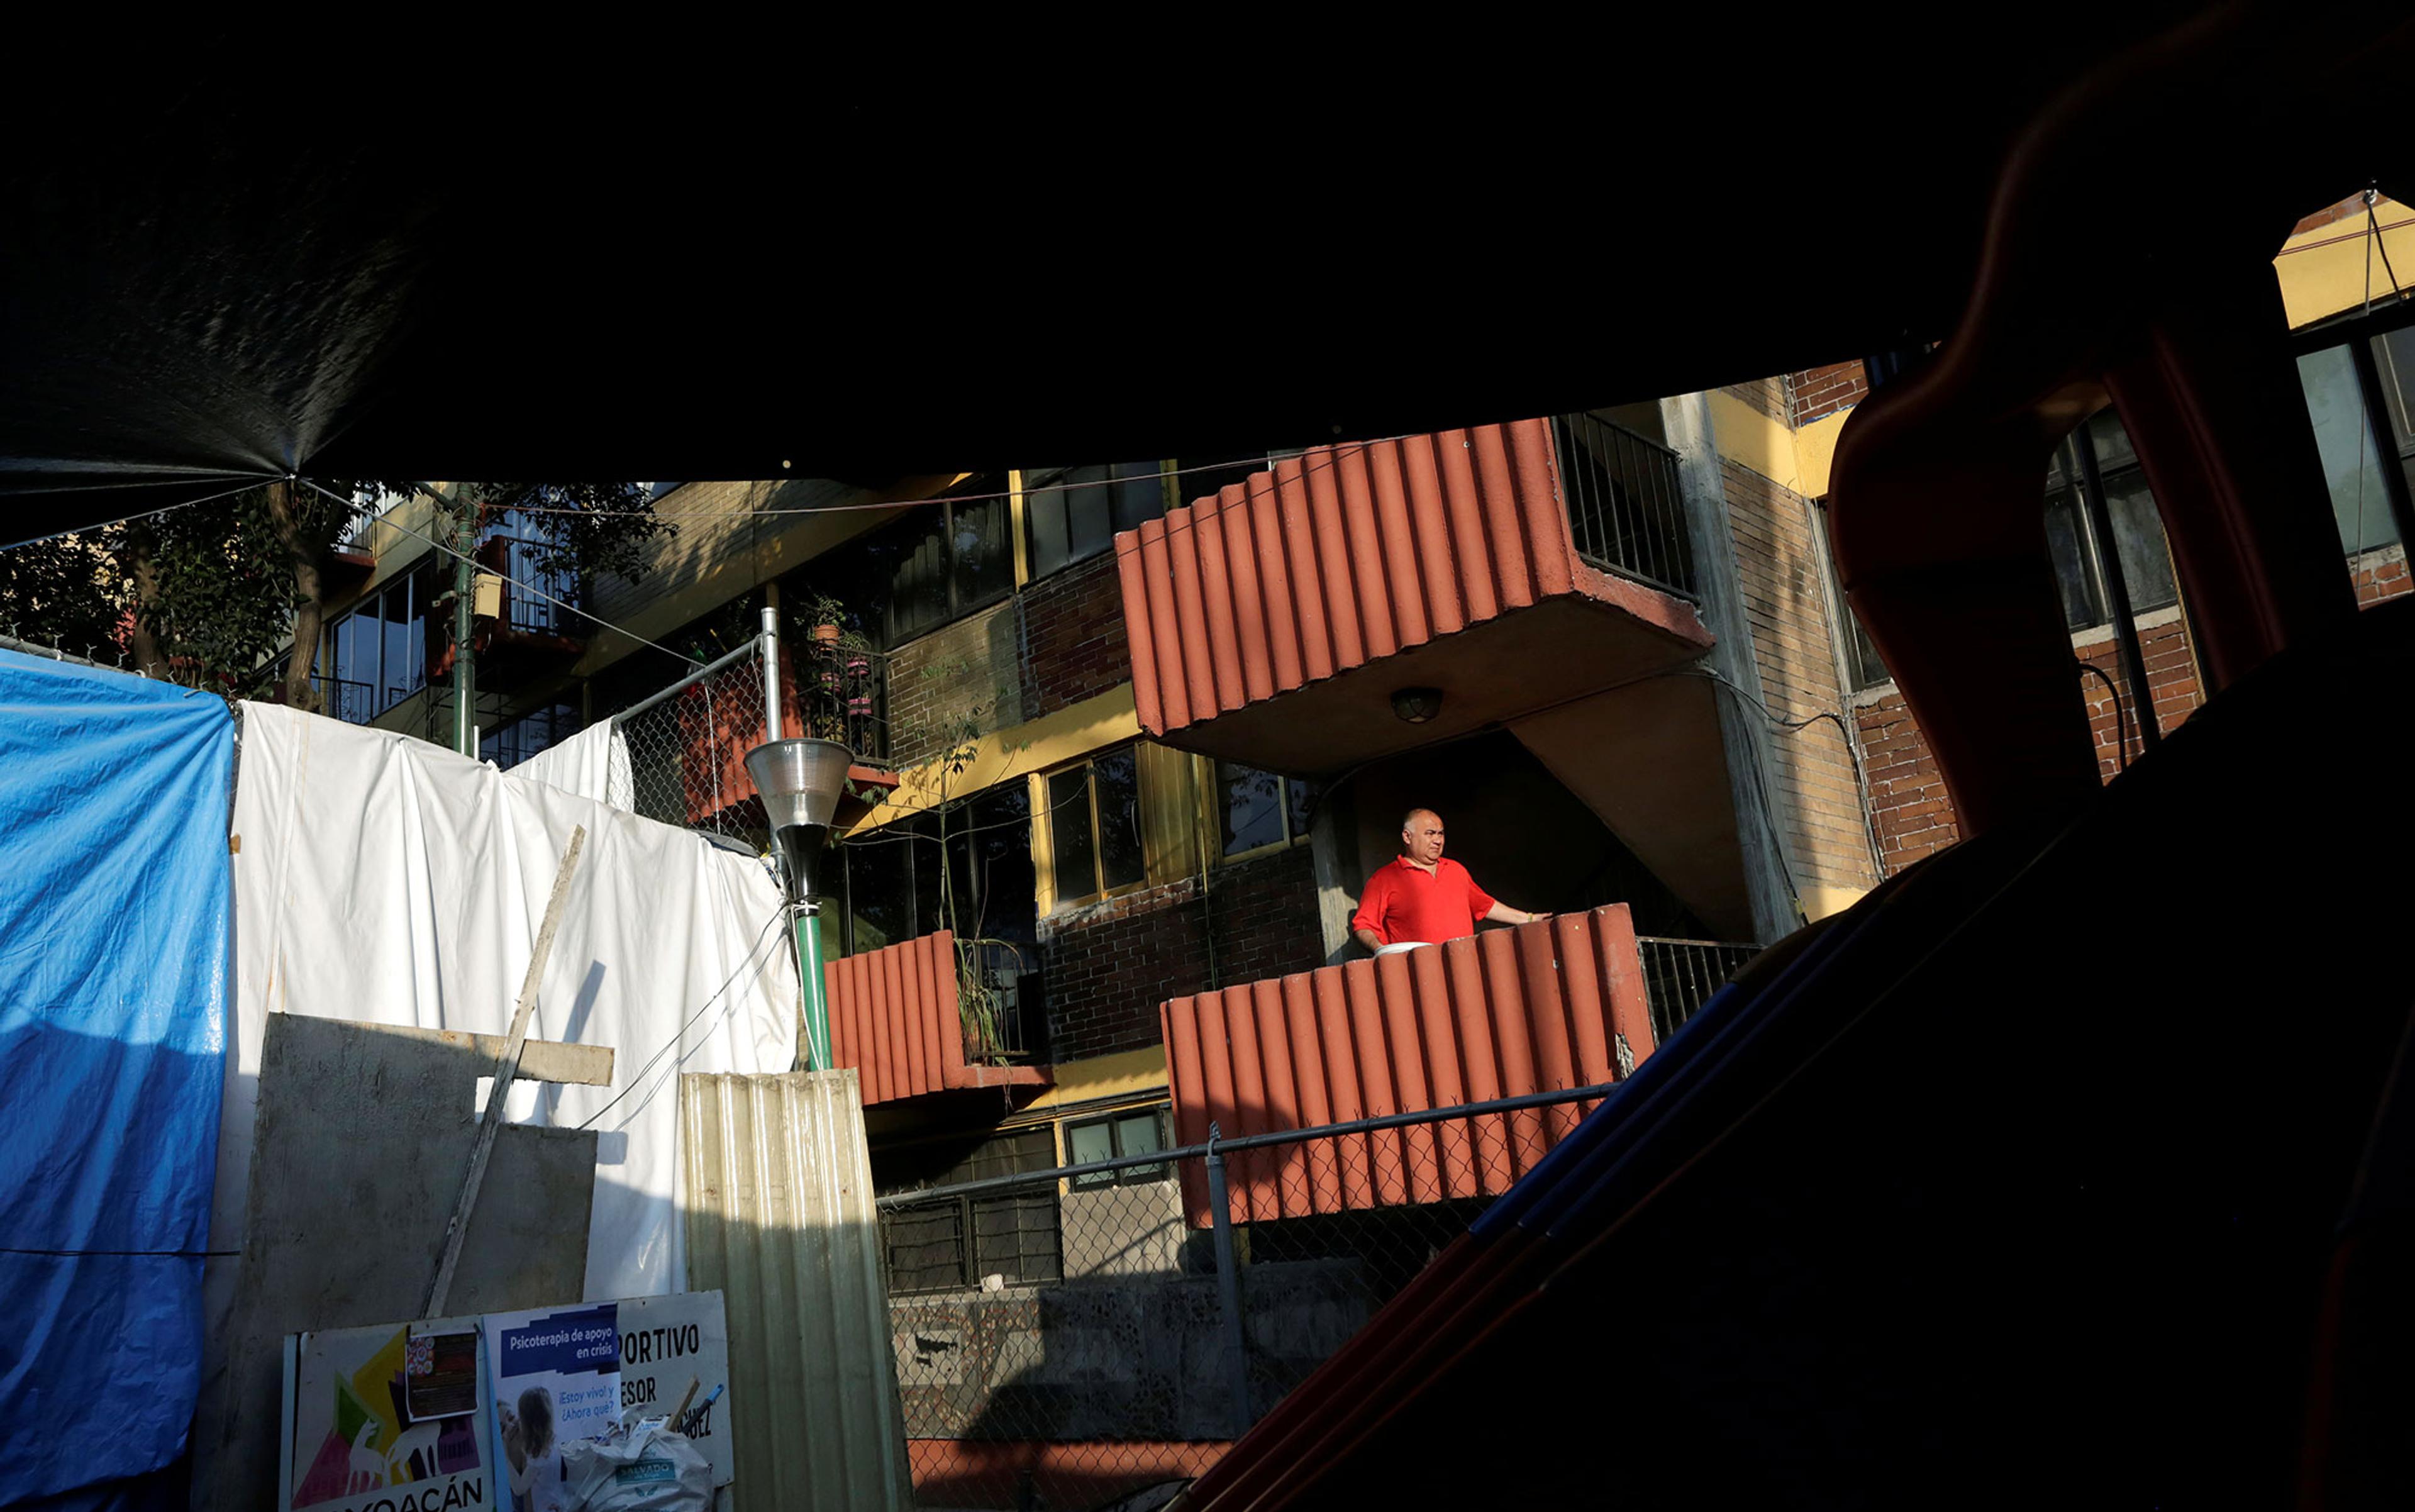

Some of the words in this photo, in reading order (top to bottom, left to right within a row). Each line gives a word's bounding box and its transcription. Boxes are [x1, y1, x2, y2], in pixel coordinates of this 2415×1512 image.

[510, 1331, 569, 1350] Psicoterapia
[570, 1328, 583, 1342] de
[585, 1326, 613, 1342] apoyo
[576, 1349, 589, 1359] en
[591, 1342, 613, 1357] crisis
[608, 1386, 614, 1398] y
[561, 1407, 592, 1421] ¿Ahora
[594, 1400, 614, 1416] qué?
